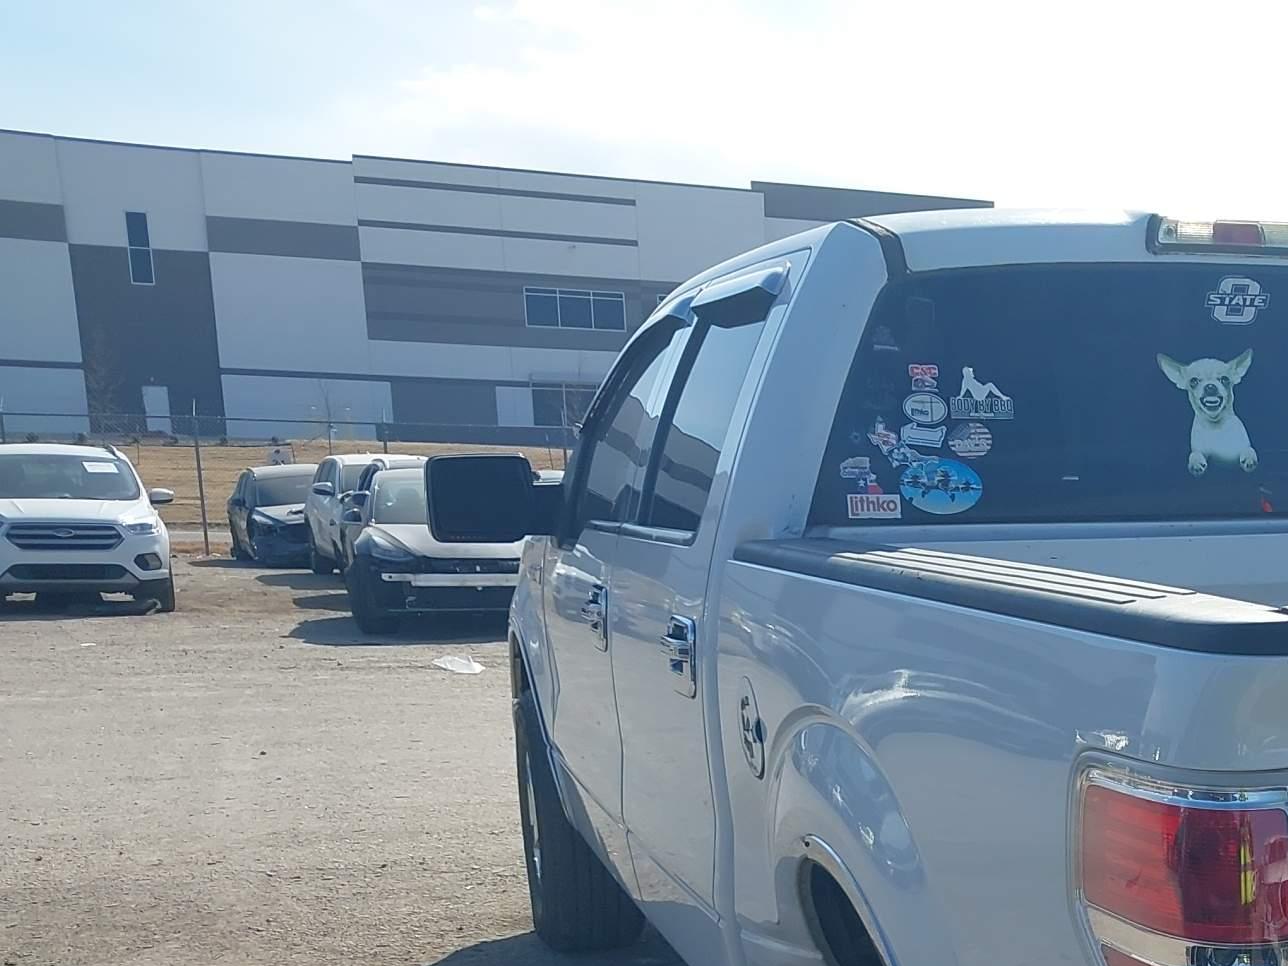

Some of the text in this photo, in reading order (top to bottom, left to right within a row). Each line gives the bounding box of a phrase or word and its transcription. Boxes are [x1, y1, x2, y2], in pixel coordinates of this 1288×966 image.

[1208, 294, 1267, 306] STATE
[951, 398, 1013, 412] BODY BY BBQ
[849, 495, 897, 517] Lithko
